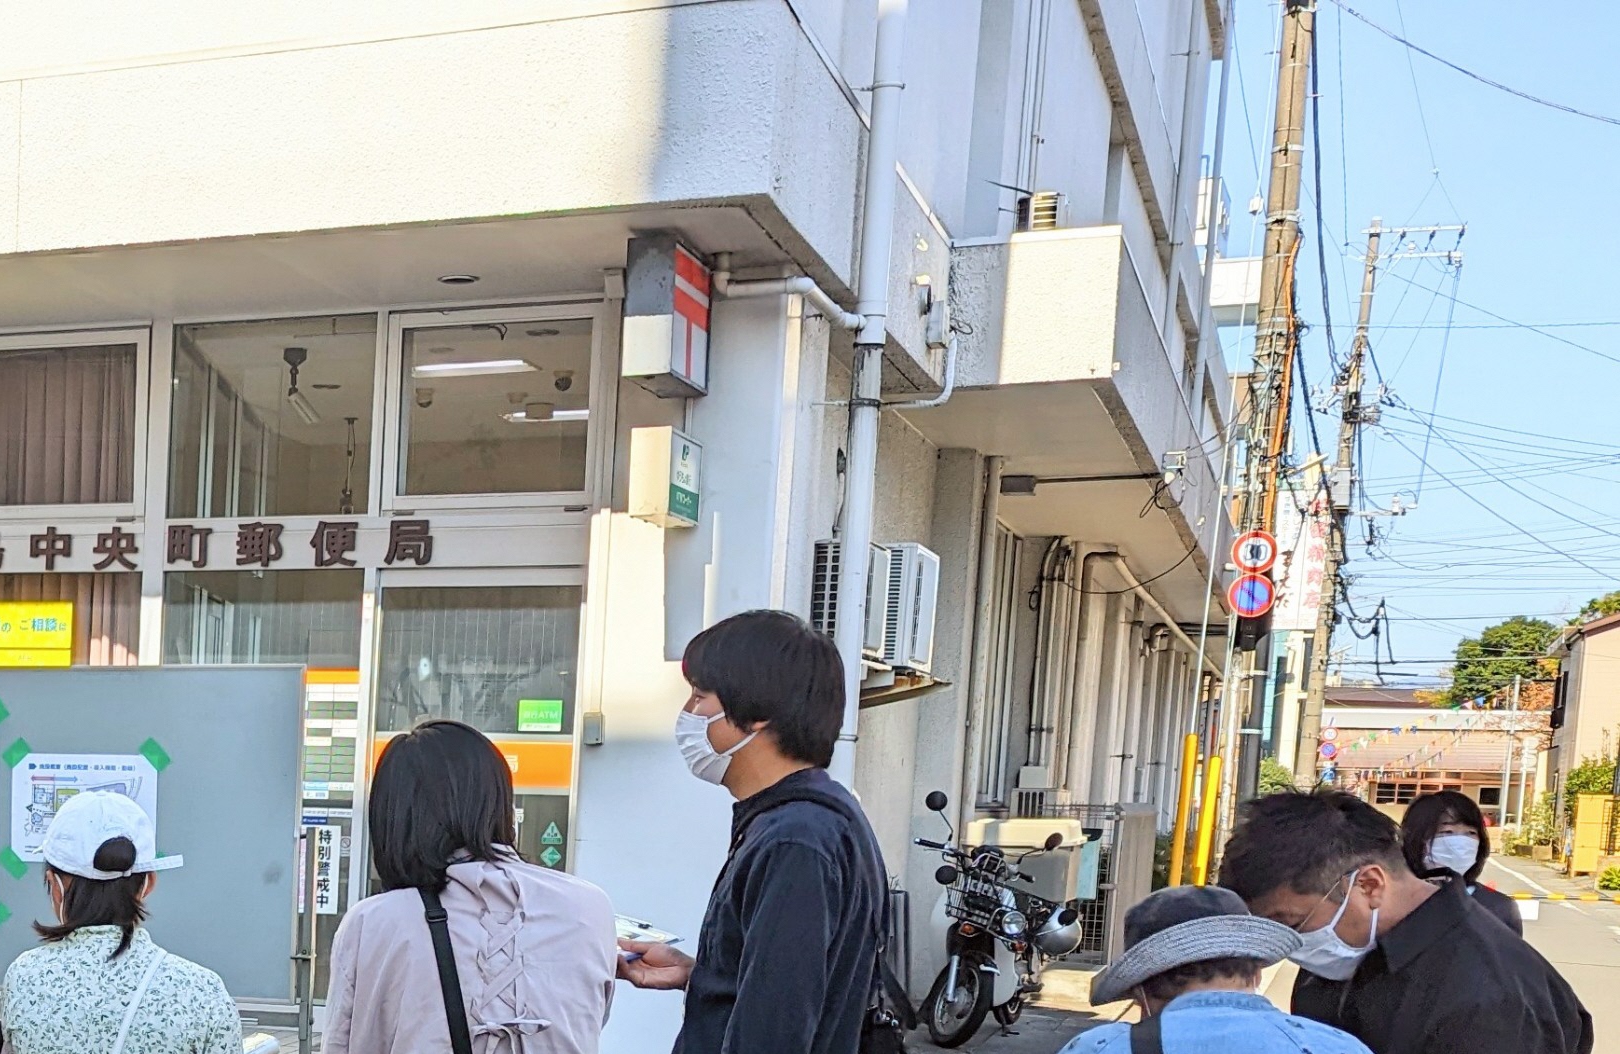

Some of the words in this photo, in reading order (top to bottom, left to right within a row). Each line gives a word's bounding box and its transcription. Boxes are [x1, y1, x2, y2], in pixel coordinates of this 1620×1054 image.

[316, 829, 333, 909] 特別警戒中
